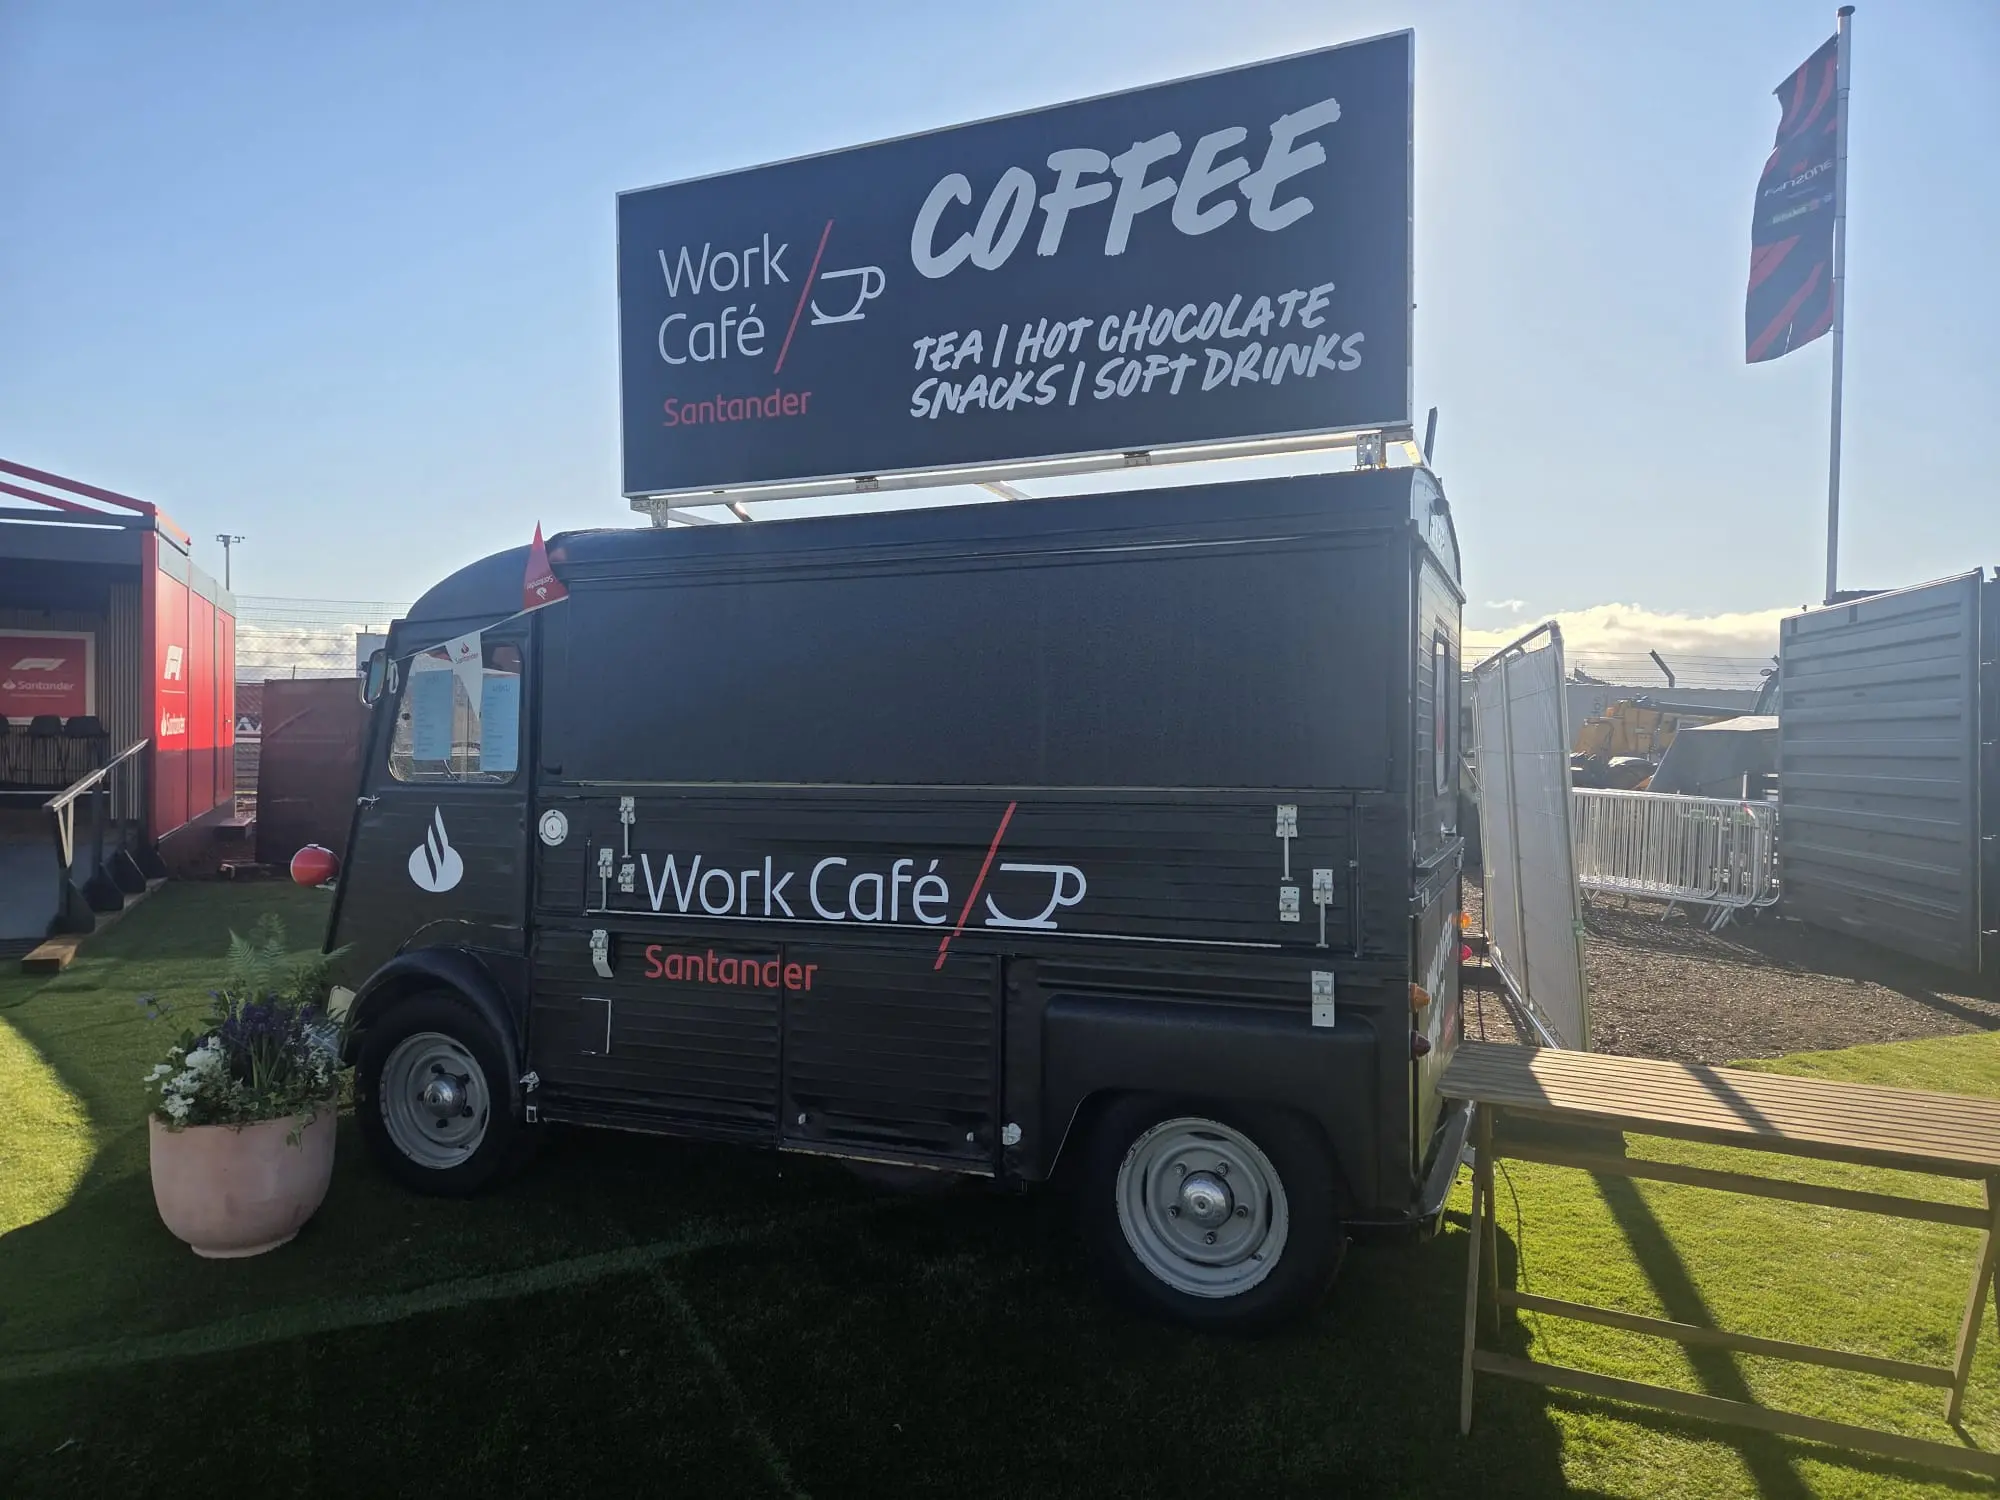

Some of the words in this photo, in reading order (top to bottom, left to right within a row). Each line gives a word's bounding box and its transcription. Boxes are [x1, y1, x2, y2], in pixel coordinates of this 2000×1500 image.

[911, 98, 1341, 279] COFFEE
[658, 233, 790, 297] Work
[658, 304, 765, 364] Café
[913, 329, 983, 372] TEA
[1015, 317, 1093, 365] HOT
[1098, 282, 1335, 353] CHOCOLATE
[663, 388, 812, 427] Santander
[910, 364, 1065, 419] SNACKS
[1093, 353, 1197, 400] SOFT
[1202, 332, 1365, 391] DRINKS
[17, 680, 75, 690] Santander
[641, 853, 795, 917] Work
[810, 857, 950, 924] Café
[644, 944, 818, 991] Santander
